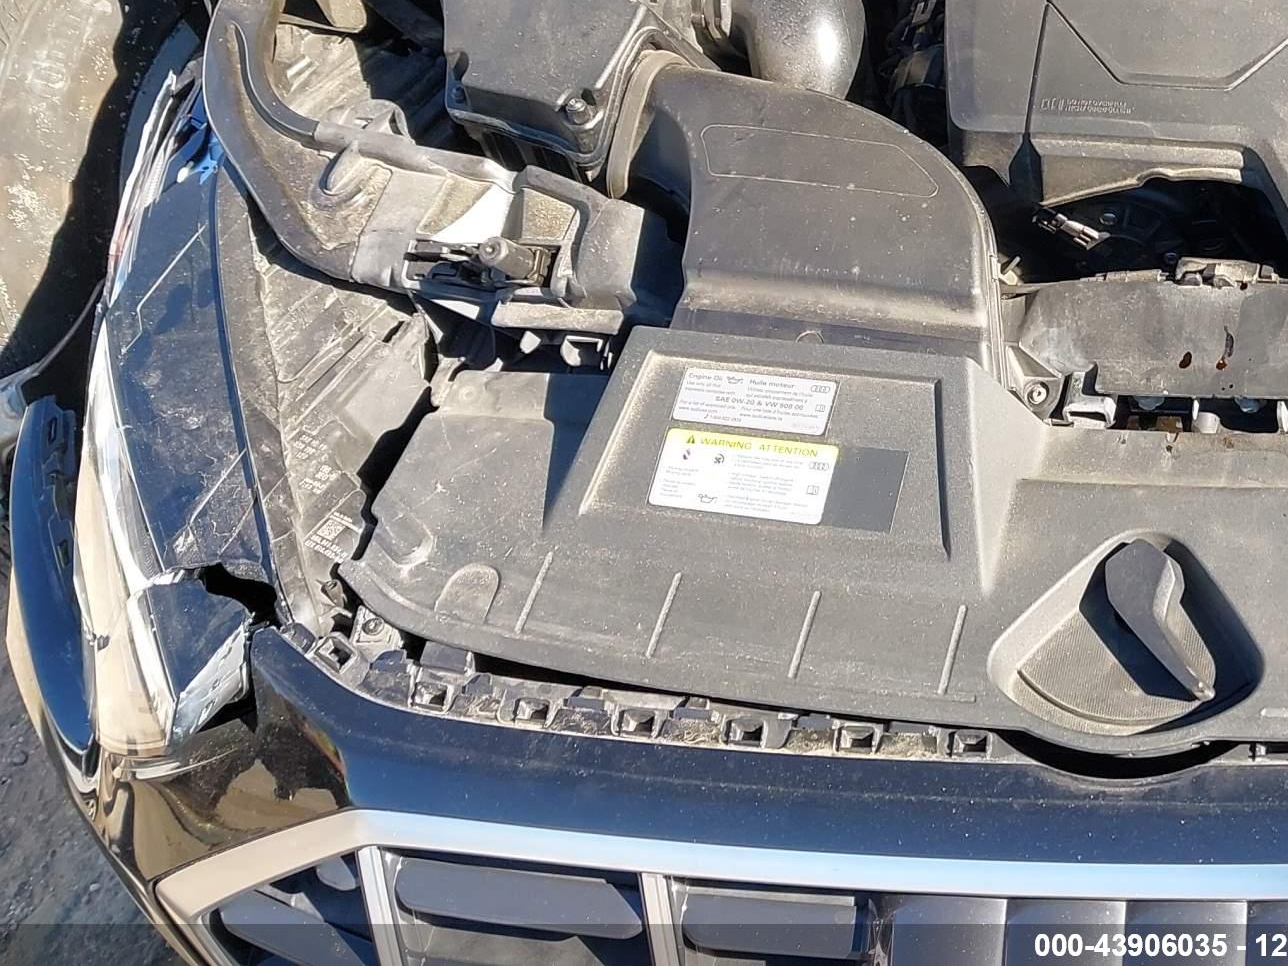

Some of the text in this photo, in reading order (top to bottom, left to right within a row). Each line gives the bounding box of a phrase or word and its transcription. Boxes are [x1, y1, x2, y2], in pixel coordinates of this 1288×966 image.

[688, 372, 713, 381] Engine
[749, 378, 795, 390] Huile moteur
[715, 395, 731, 404] SAE
[765, 401, 779, 409] VW
[701, 437, 818, 458] WARNING ATTENTION
